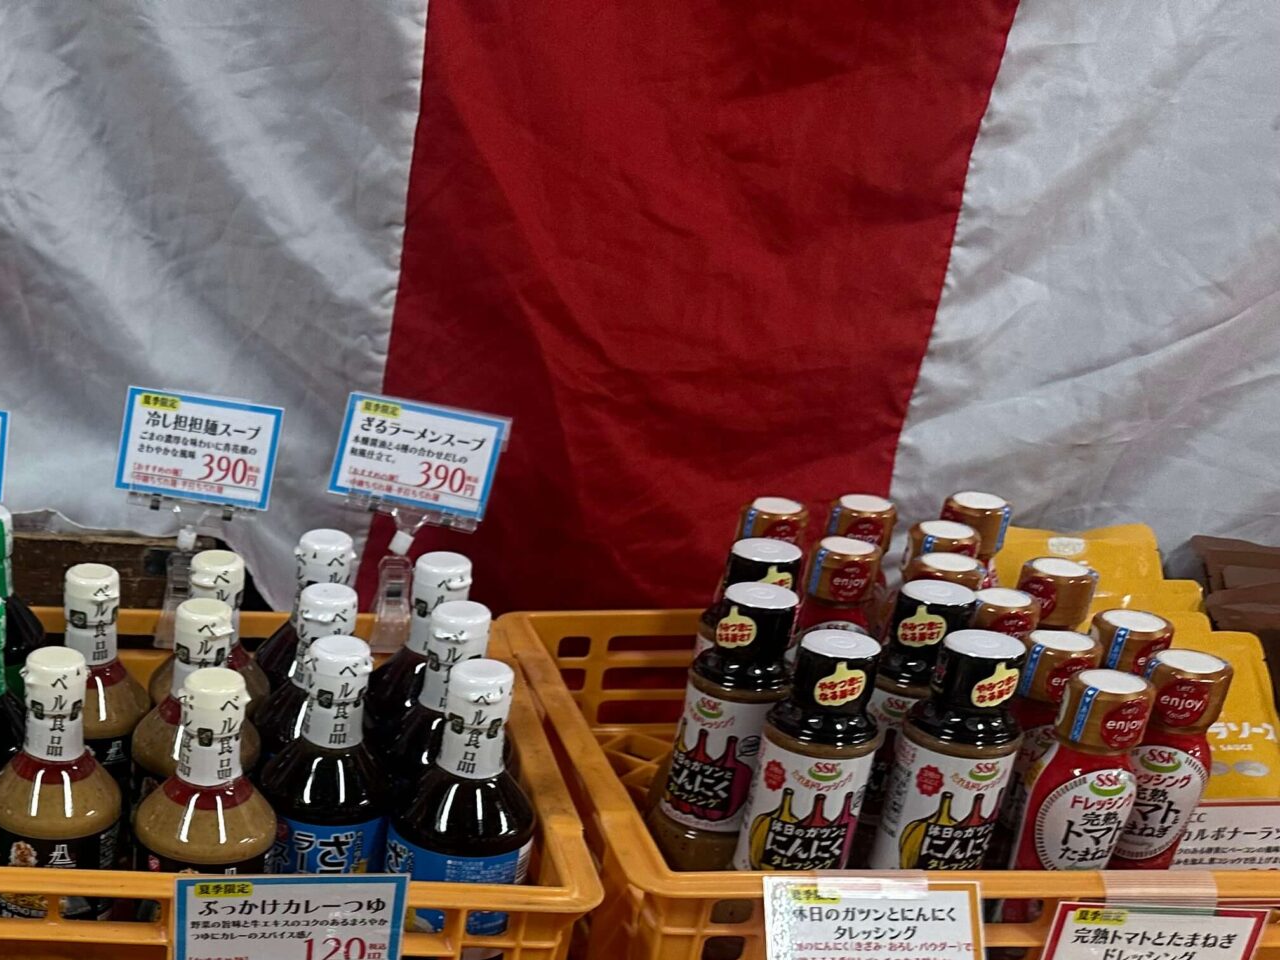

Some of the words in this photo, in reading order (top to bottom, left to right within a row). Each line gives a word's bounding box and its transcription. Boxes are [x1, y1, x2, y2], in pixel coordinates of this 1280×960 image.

[146, 411, 262, 440] 冷し担担麺スープ
[361, 417, 487, 451] ざるラーメンスープ
[832, 575, 866, 588] enjoy
[93, 585, 110, 661] ベル食品
[328, 663, 357, 745] ベル食品
[1160, 695, 1203, 710] enjoy
[47, 675, 68, 757] ベル食品
[1106, 719, 1143, 731] enjoy
[217, 695, 240, 779] ベル食品
[456, 694, 490, 773] ベル食品
[814, 762, 840, 774] SSK
[972, 762, 999, 774] SSK
[767, 835, 843, 859] にんにく
[199, 884, 250, 895] 夏季限定
[199, 898, 386, 916] ぶっかけカレーつゆ
[792, 907, 957, 922] 休日のガツンとにんにく
[834, 926, 917, 940] タレッシング
[1072, 927, 1238, 949] 完熟トマトとたまねぎ
